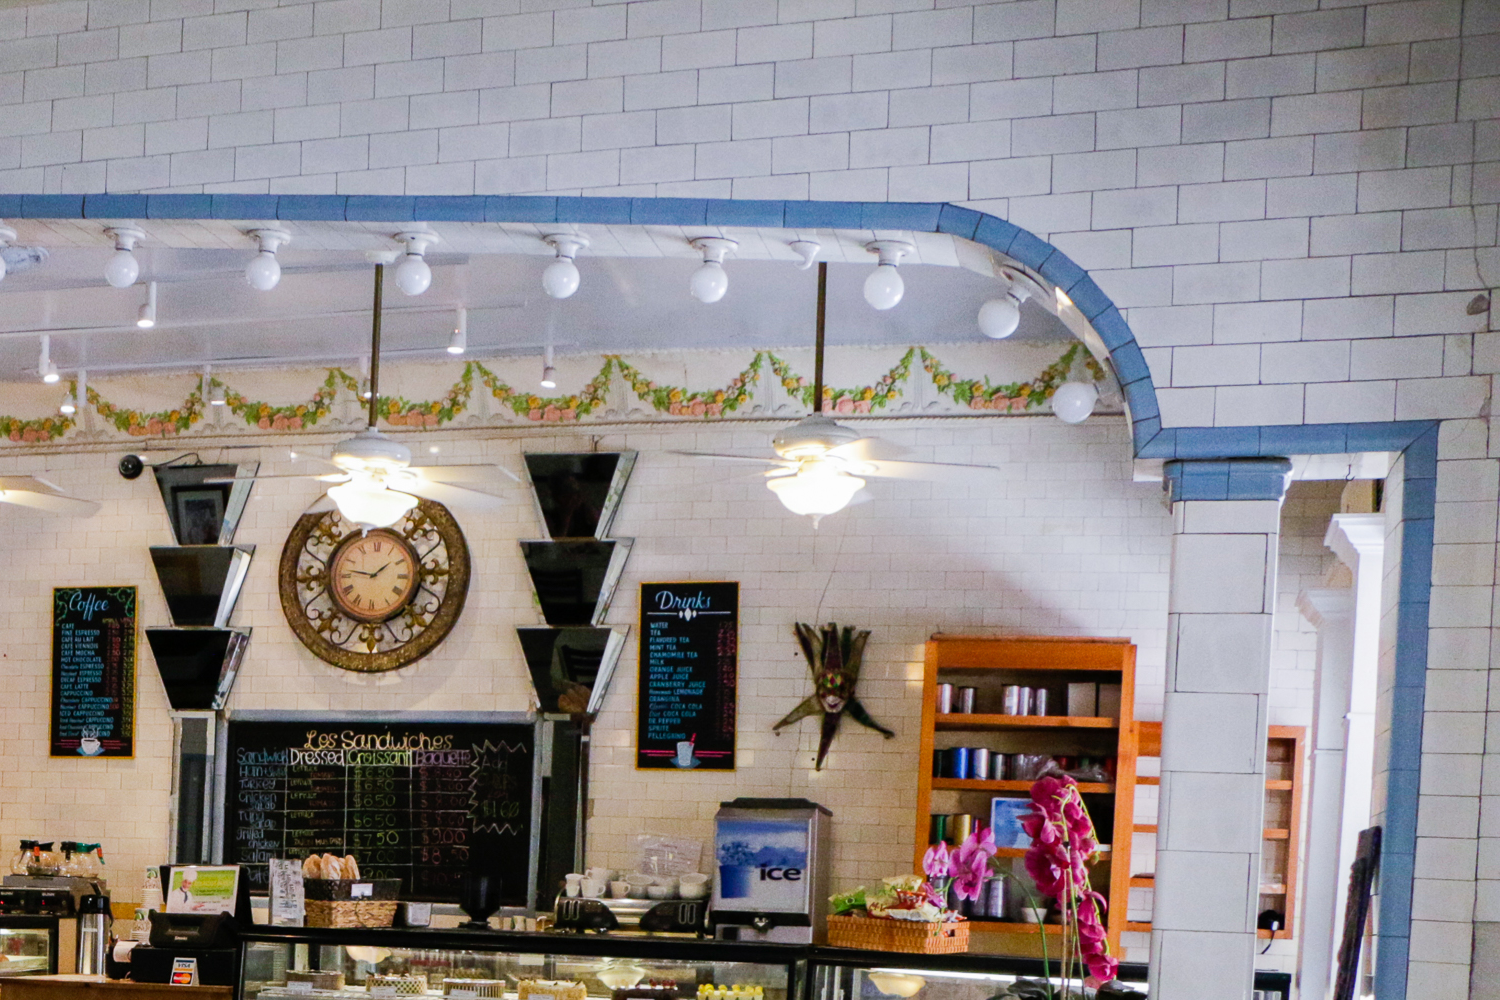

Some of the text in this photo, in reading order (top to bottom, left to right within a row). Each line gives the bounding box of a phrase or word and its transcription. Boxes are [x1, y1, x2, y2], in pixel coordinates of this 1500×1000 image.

[69, 591, 109, 621] Coffee
[655, 590, 711, 610] Drinks
[304, 730, 454, 750] Les Sandwiches
[236, 747, 472, 767] Sandwich Dressed Croissant Baguette
[238, 792, 277, 803] Chicken
[760, 864, 801, 881] ice
